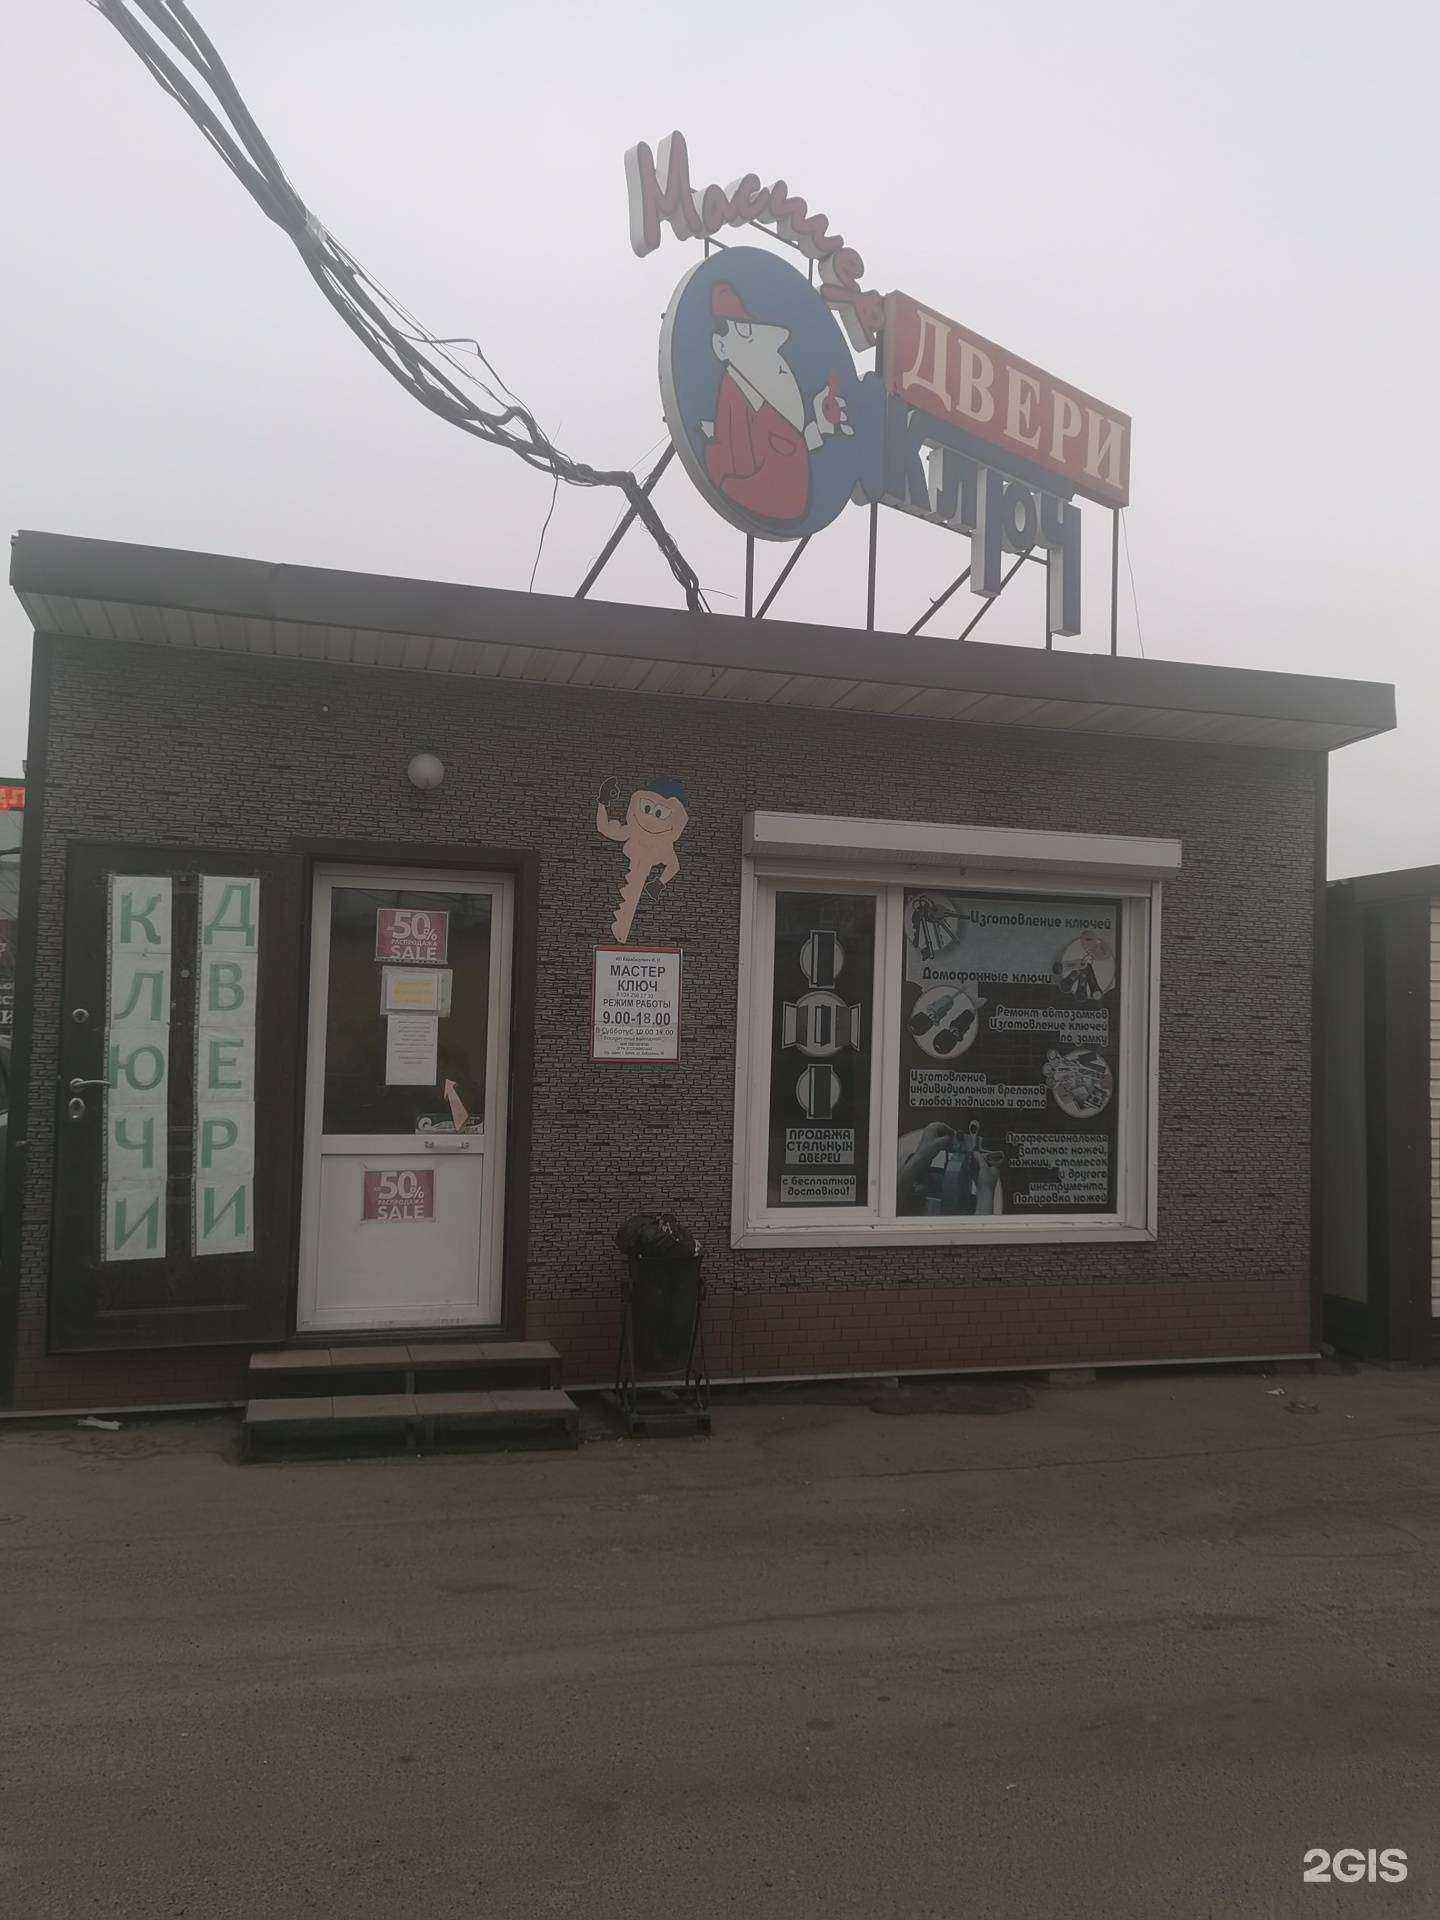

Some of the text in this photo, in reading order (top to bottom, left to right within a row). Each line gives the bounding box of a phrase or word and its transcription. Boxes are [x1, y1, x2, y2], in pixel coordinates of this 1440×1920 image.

[902, 309, 1127, 490] ДВЕРИ
[970, 910, 1112, 930] Изготовление ключей
[390, 945, 437, 961] SALE
[610, 965, 666, 978] МАСТЕР
[922, 966, 1052, 986] Домофонные ключи
[618, 980, 658, 992] КЛЮЧ
[603, 999, 671, 1009] РЕЖИМ РАБОТЫ
[602, 1011, 671, 1025] 9.00-18.00
[997, 1005, 1108, 1020] Ремонт автозамков
[990, 1018, 1107, 1032] Изготовление ключей
[1060, 1034, 1073, 1043] по
[202, 883, 256, 1239] ДВЕРИ
[109, 892, 165, 1251] КЛЮЧИ
[789, 1129, 851, 1140] ПРОДАЖА
[786, 1141, 853, 1152] СТАЛЬНЫХ
[787, 1186, 850, 1196] доставкой!
[377, 1205, 425, 1219] SALE
